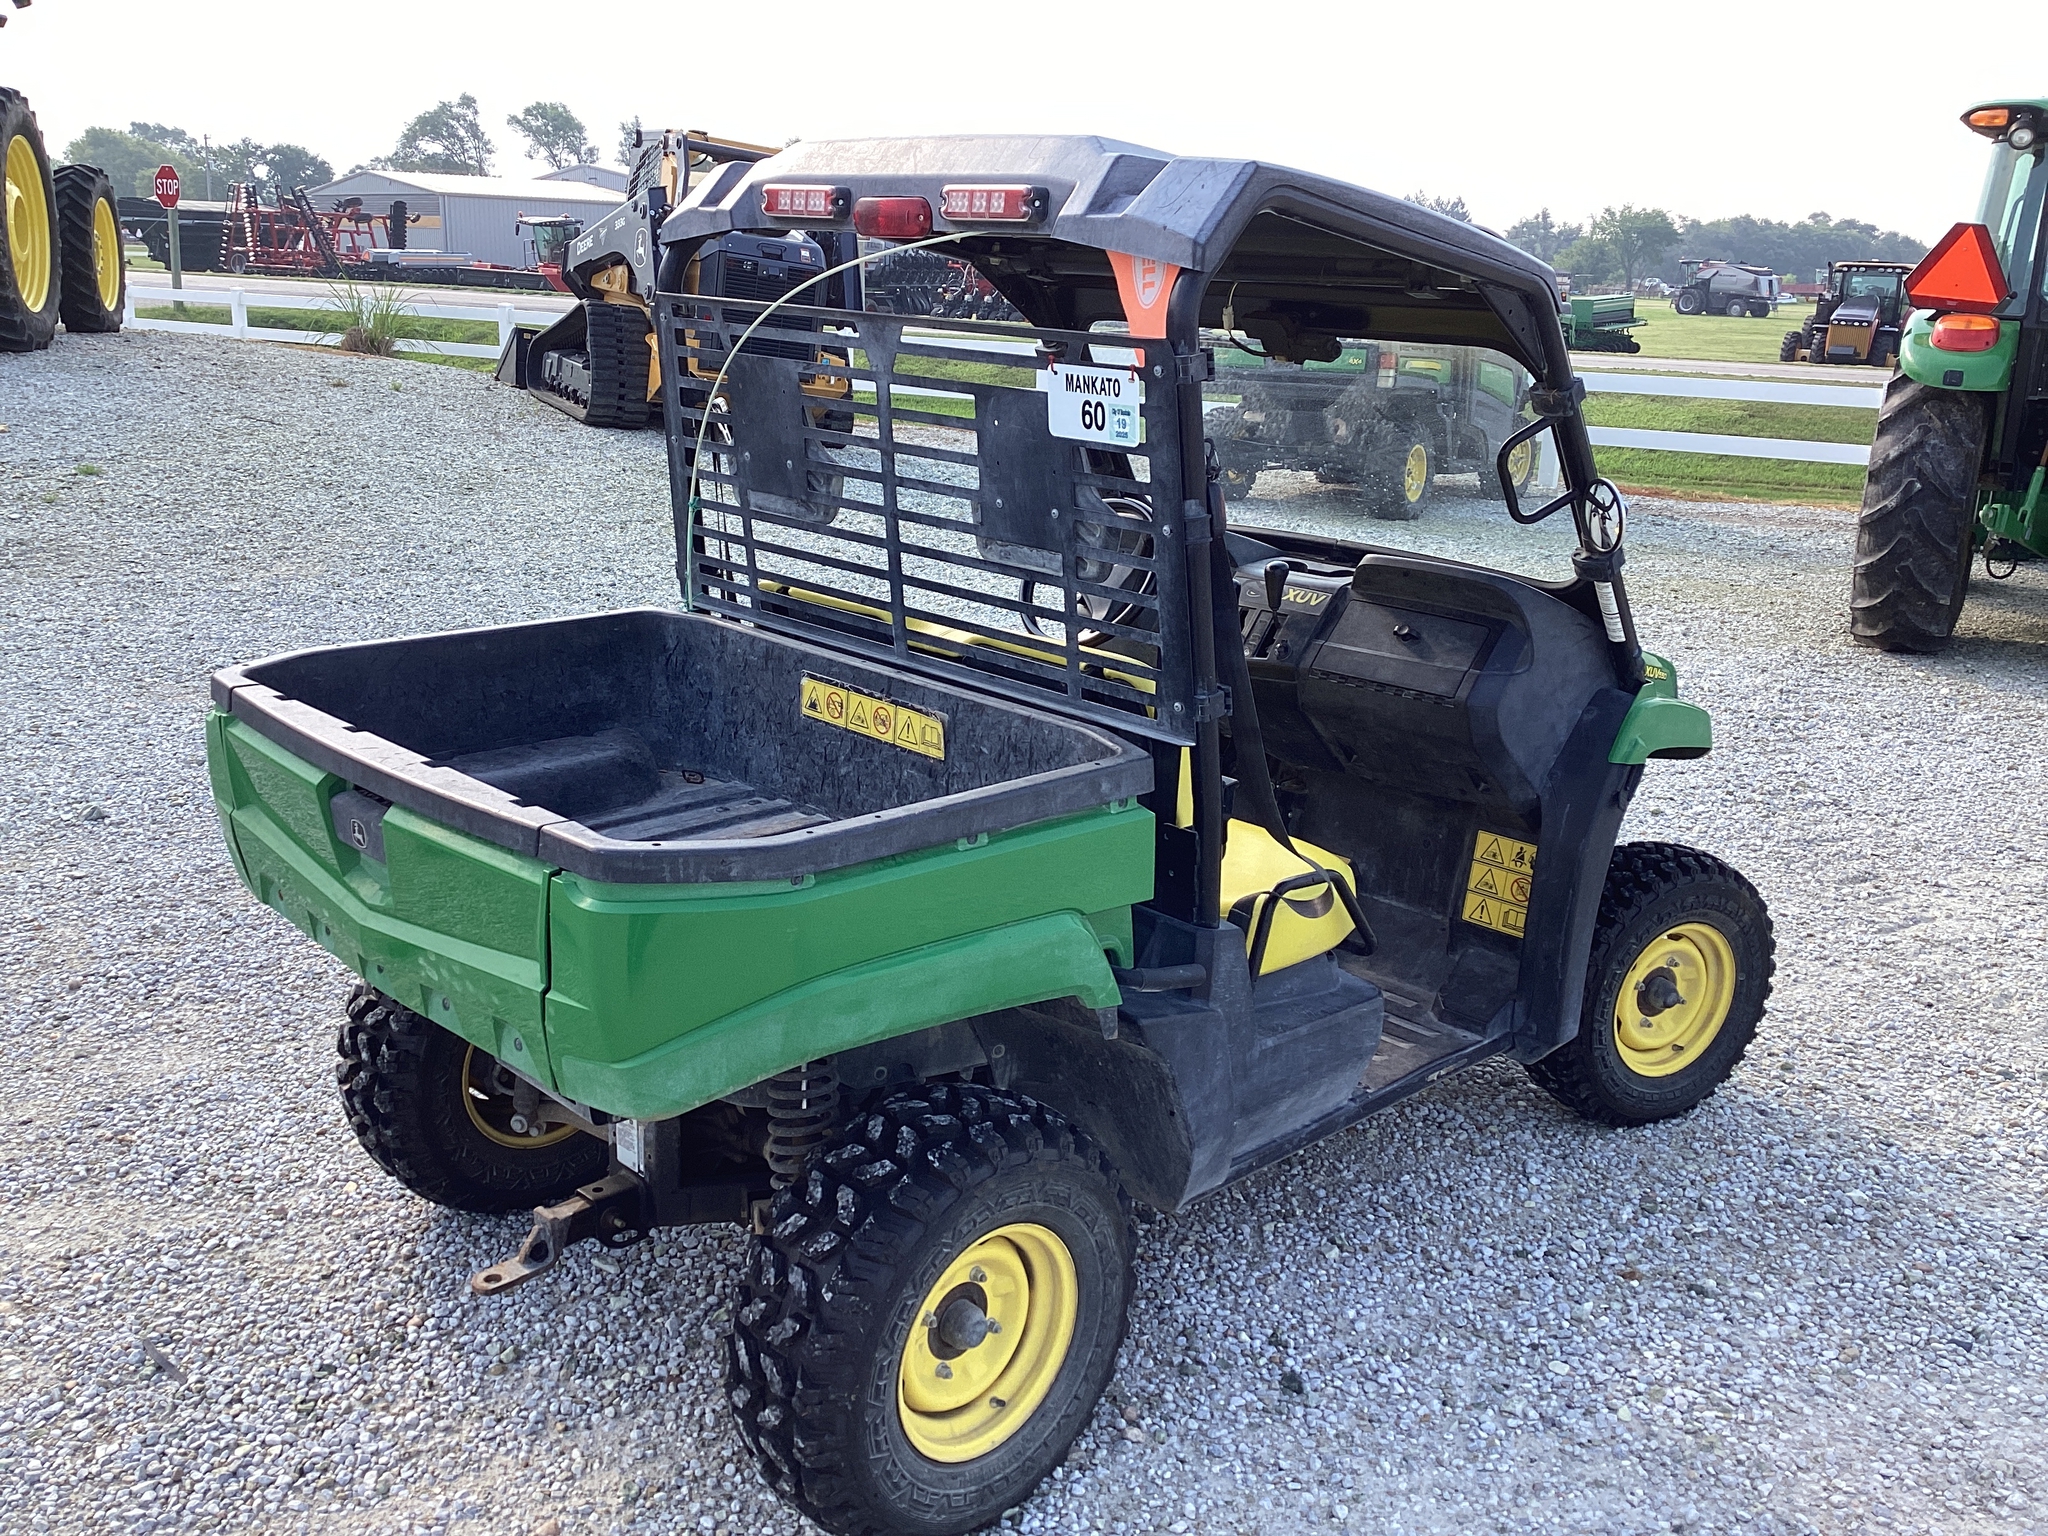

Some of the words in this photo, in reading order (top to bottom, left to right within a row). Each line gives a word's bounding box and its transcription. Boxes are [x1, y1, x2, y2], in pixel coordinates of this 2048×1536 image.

[156, 178, 179, 195] STOP
[576, 234, 594, 256] DEERE
[1065, 372, 1121, 398] MANKATO
[1081, 399, 1106, 432] 60
[1116, 418, 1127, 429] 19
[1281, 588, 1327, 606] XUV
